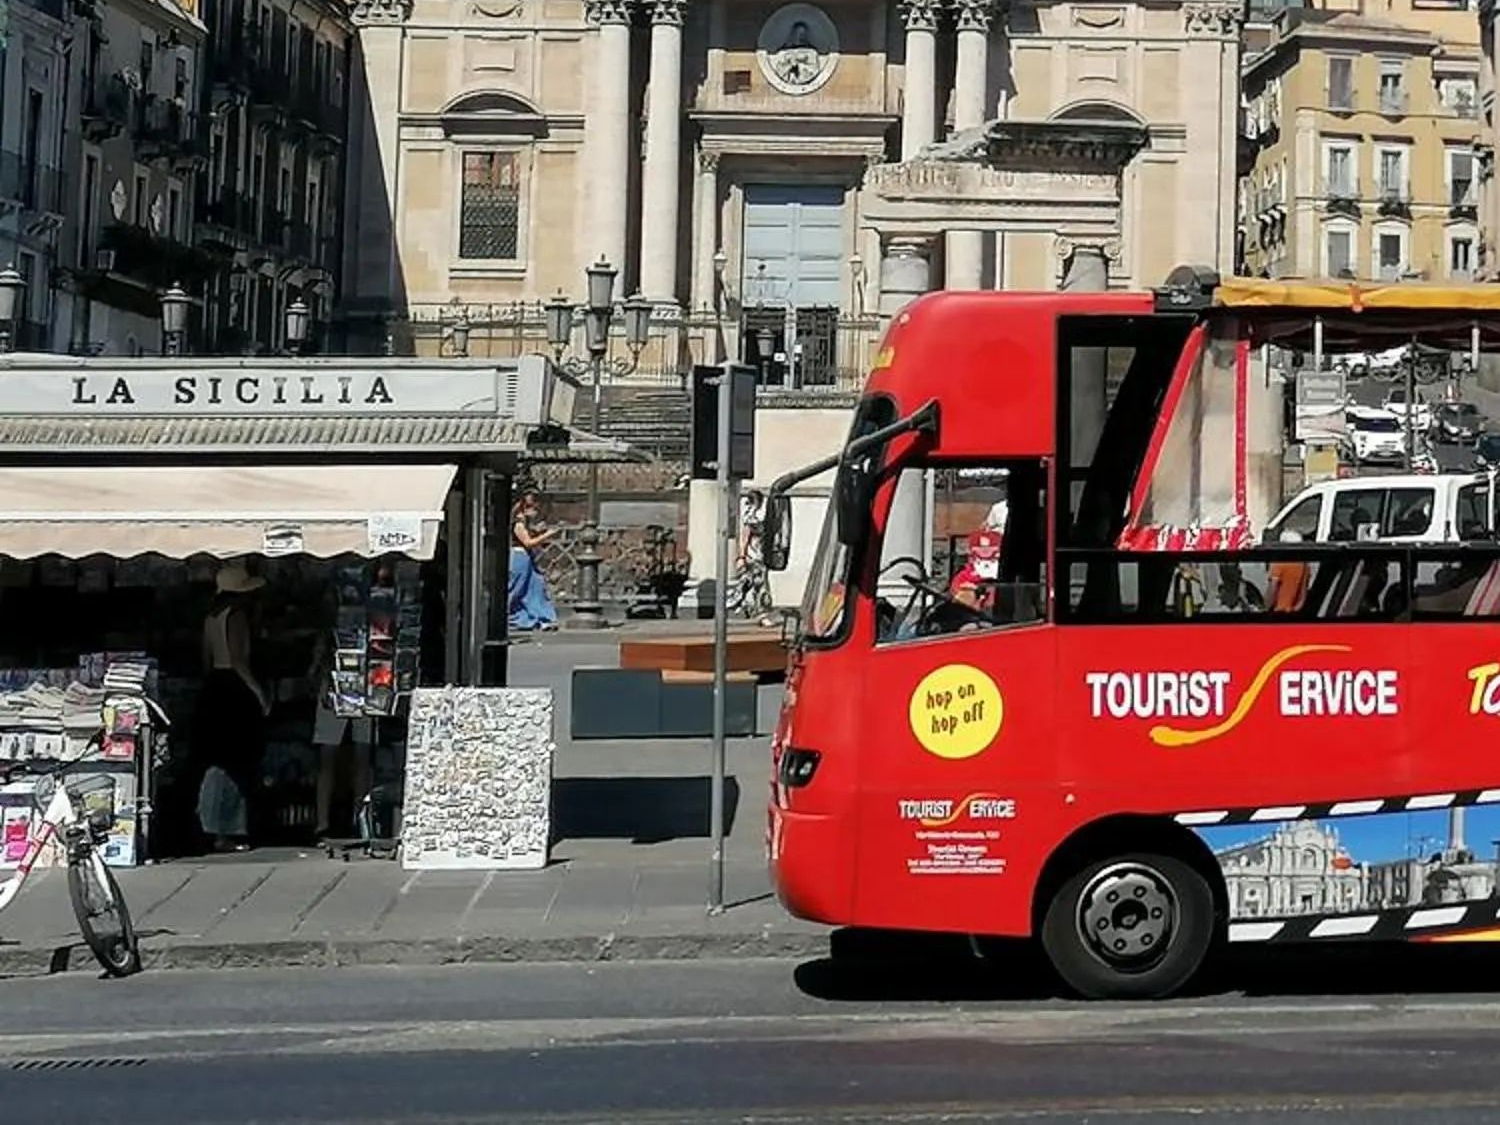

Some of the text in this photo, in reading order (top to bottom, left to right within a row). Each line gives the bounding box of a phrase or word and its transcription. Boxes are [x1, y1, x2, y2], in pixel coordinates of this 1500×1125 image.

[72, 377, 394, 404] LA SICILIA
[926, 684, 975, 710] hop on
[931, 700, 985, 736] hop off
